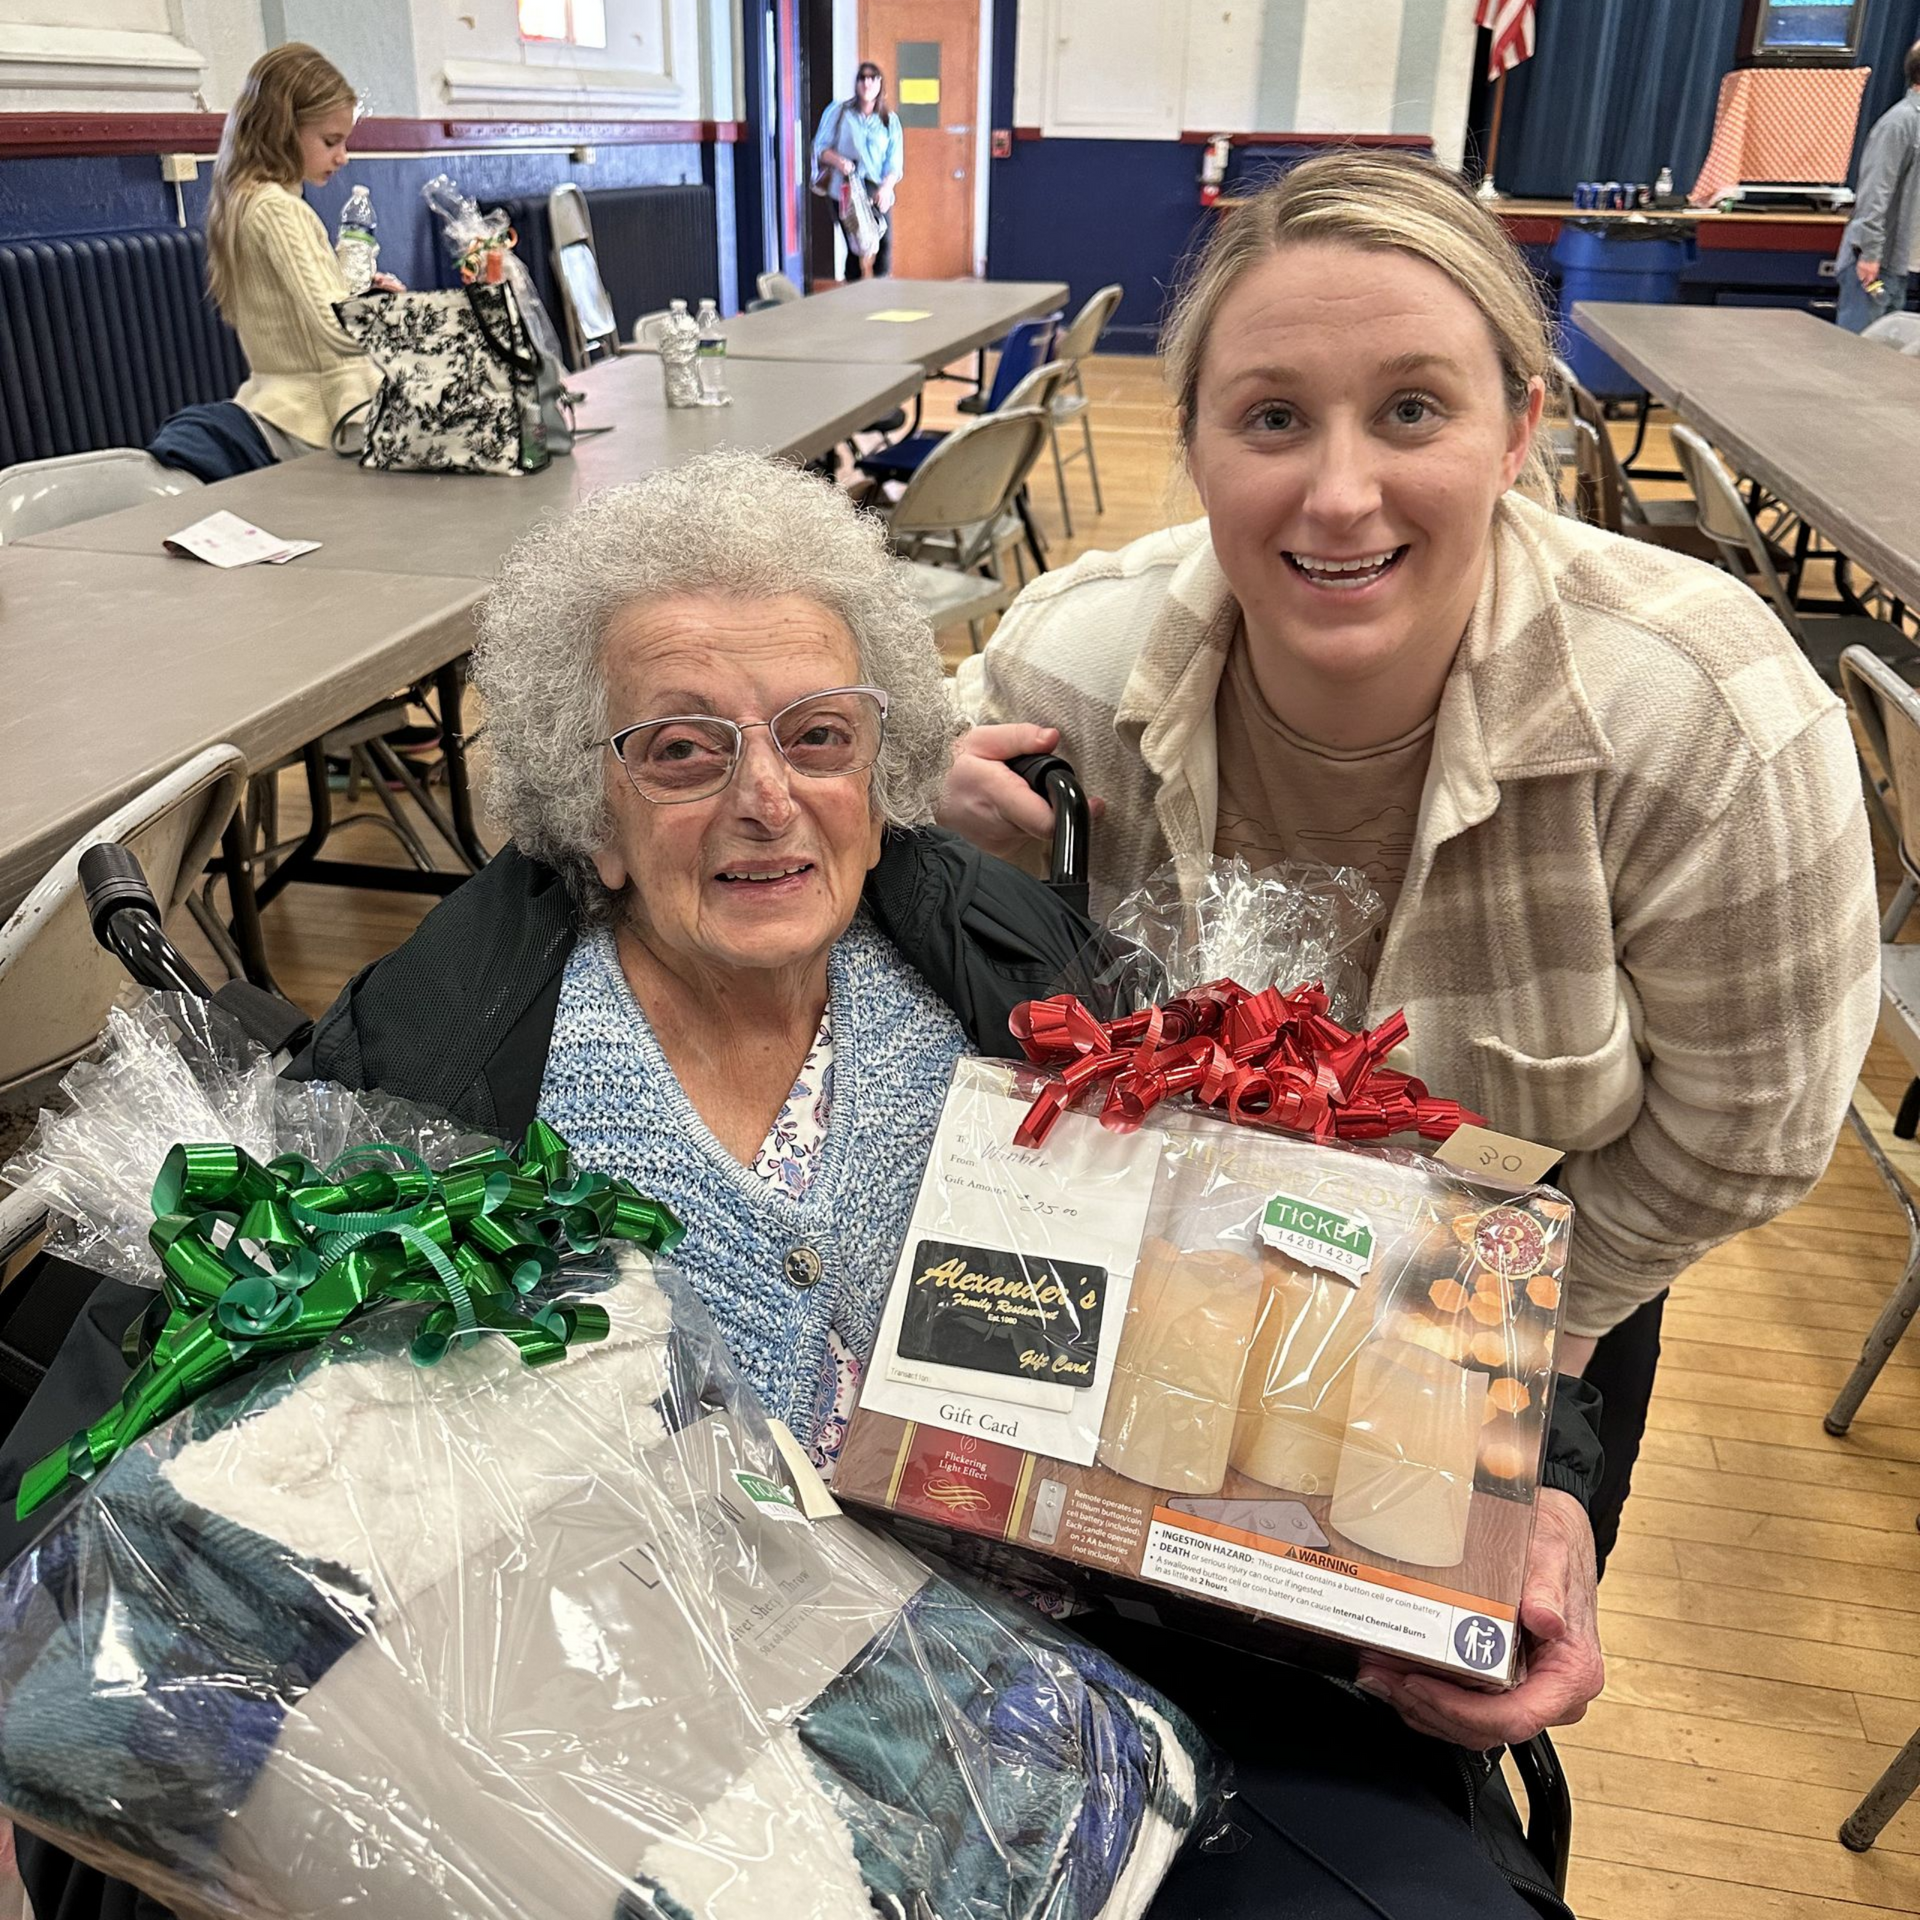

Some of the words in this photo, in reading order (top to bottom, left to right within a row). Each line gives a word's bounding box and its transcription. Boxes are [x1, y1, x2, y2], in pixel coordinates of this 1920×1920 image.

[1478, 1144, 1523, 1173] 30
[944, 1174, 965, 1186] Gift
[1277, 1202, 1365, 1248] TICKET
[1278, 1229, 1354, 1265] 14281423
[951, 1292, 993, 1313] Family
[1019, 1349, 1050, 1372] Gift
[1051, 1354, 1092, 1375] Card
[939, 1403, 975, 1426] Gift
[979, 1413, 1019, 1437] Card
[938, 1459, 961, 1473] Light
[962, 1466, 988, 1481] Effect
[944, 1450, 988, 1472] Flickering
[1074, 1489, 1101, 1504] Remote
[1101, 1499, 1132, 1513] operates
[1075, 1499, 1101, 1513] lithium
[1101, 1508, 1142, 1526] button/coin
[1066, 1509, 1079, 1518] cell
[1079, 1512, 1105, 1527] battery
[1065, 1519, 1082, 1531] Each
[1083, 1525, 1107, 1537] candle
[1106, 1532, 1138, 1547] operates
[1070, 1533, 1080, 1541] on
[1080, 1535, 1086, 1543] 2
[1086, 1536, 1097, 1546] AA
[1097, 1540, 1129, 1555] batteries
[1071, 1543, 1087, 1554] (not
[1154, 1565, 1163, 1574] in
[1163, 1569, 1172, 1577] as
[1172, 1570, 1189, 1581] little
[1198, 1577, 1205, 1585] 2
[1159, 1542, 1191, 1558] DEATH
[1191, 1553, 1200, 1561] or
[1200, 1555, 1226, 1569] serious
[1227, 1562, 1248, 1575] injury
[1248, 1570, 1262, 1579] can
[1263, 1573, 1284, 1585] occur
[1284, 1579, 1291, 1588] if
[1290, 1582, 1324, 1597] ingested.
[1161, 1529, 1213, 1552] INGESTION
[1213, 1544, 1255, 1564] HAZARD:
[1257, 1558, 1273, 1570] This
[1273, 1564, 1304, 1579] product
[1304, 1572, 1337, 1588] contains
[1343, 1583, 1370, 1597] button
[1371, 1592, 1385, 1601] cell
[1385, 1595, 1394, 1603] or
[1395, 1598, 1412, 1609] coin
[1299, 1549, 1359, 1576] WARNING
[778, 1569, 811, 1594] Throw
[1164, 1558, 1202, 1575] swallowed
[1202, 1569, 1228, 1582] button
[1228, 1577, 1242, 1586] cell
[1242, 1581, 1251, 1589] or
[1251, 1583, 1268, 1594] coin
[1268, 1588, 1296, 1603] battery
[1296, 1595, 1310, 1605] can
[1310, 1600, 1332, 1613] cause
[1332, 1606, 1365, 1622] Internal
[1365, 1616, 1402, 1632] Chemical
[1402, 1626, 1427, 1640] Burns
